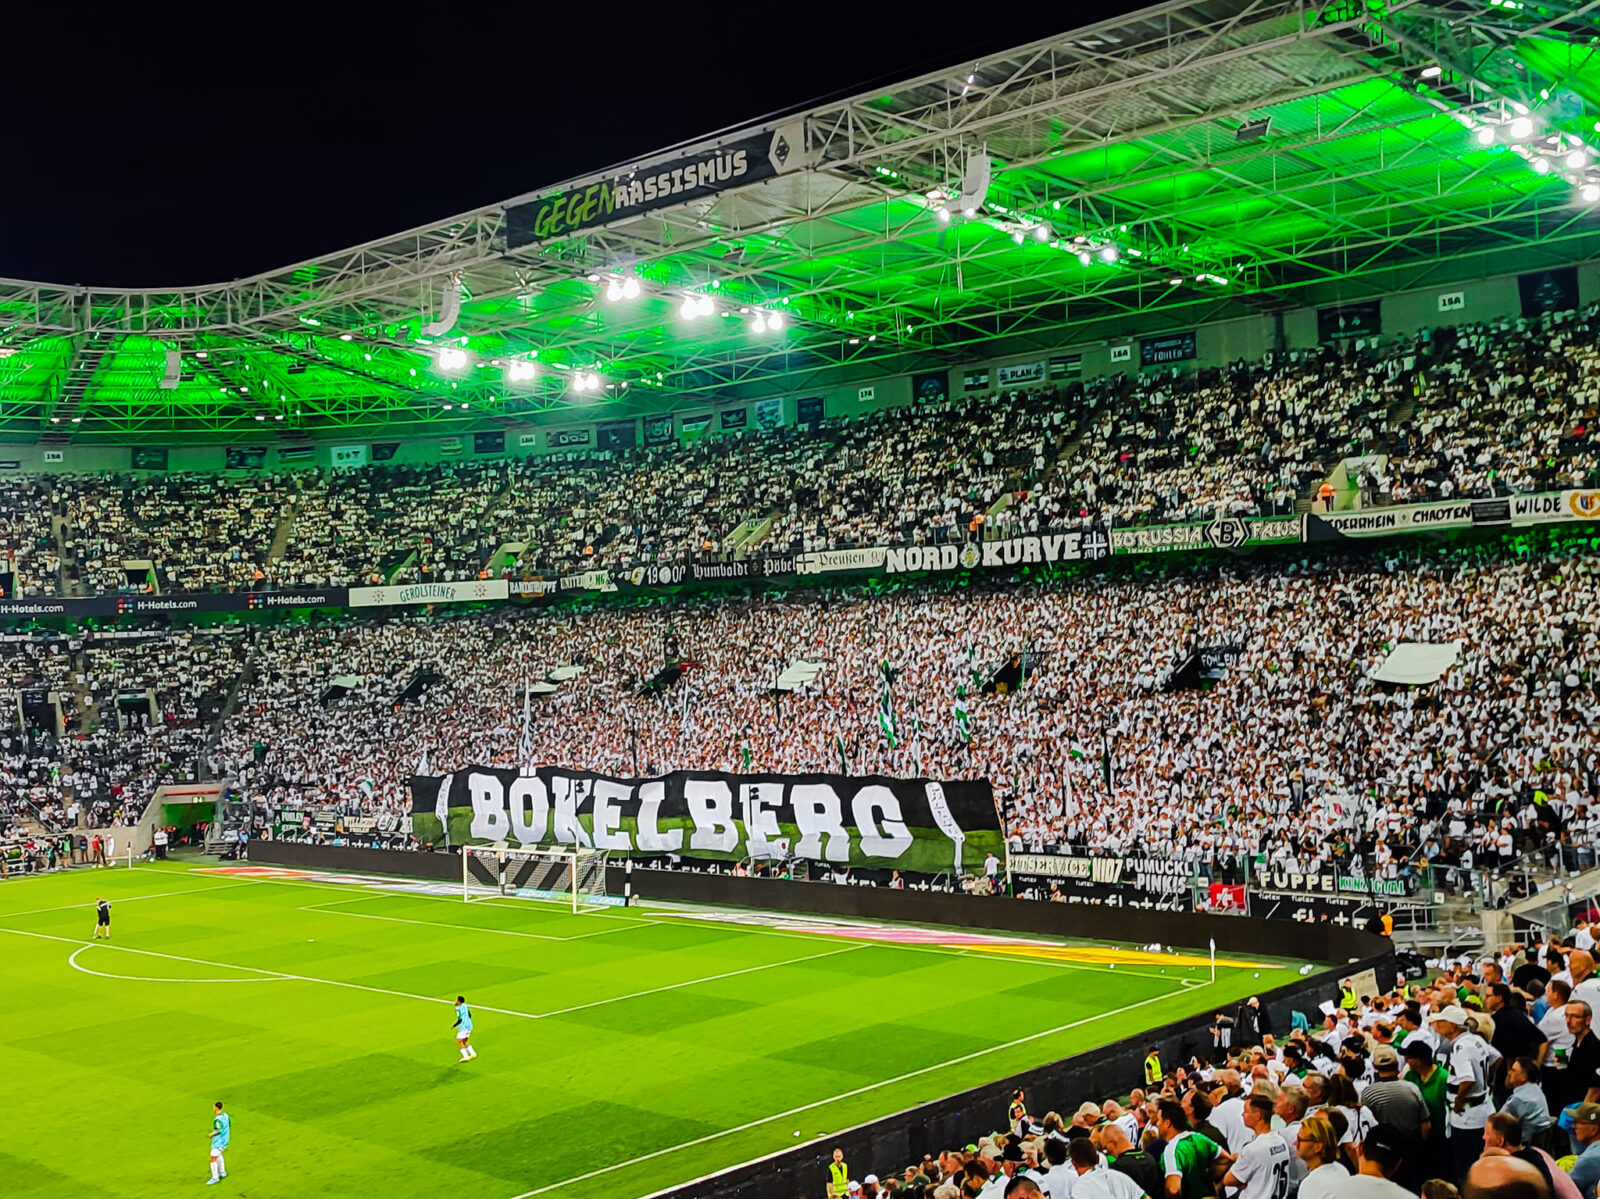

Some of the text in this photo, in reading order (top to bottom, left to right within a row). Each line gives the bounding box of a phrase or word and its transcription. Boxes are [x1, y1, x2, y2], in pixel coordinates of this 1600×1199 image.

[534, 150, 748, 238] GEGEN RASSISMUS
[1010, 367, 1033, 380] PLAN
[1516, 497, 1561, 514] WILDE
[1113, 526, 1202, 548] BORUSSIA
[886, 532, 1082, 573] NORD KURVE
[693, 556, 798, 581] Humboldt Pöbel
[267, 594, 326, 605] H-Hotels.com
[400, 584, 456, 602] GEROLSTEINER
[1, 604, 64, 614] H-Hotels.com
[137, 600, 197, 610] H-Hotels.com
[468, 772, 914, 863] BOKELBERG
[1126, 857, 1194, 876] PUMUCKL
[1136, 873, 1187, 895] PINKIS
[1260, 871, 1334, 892] FUPPE
